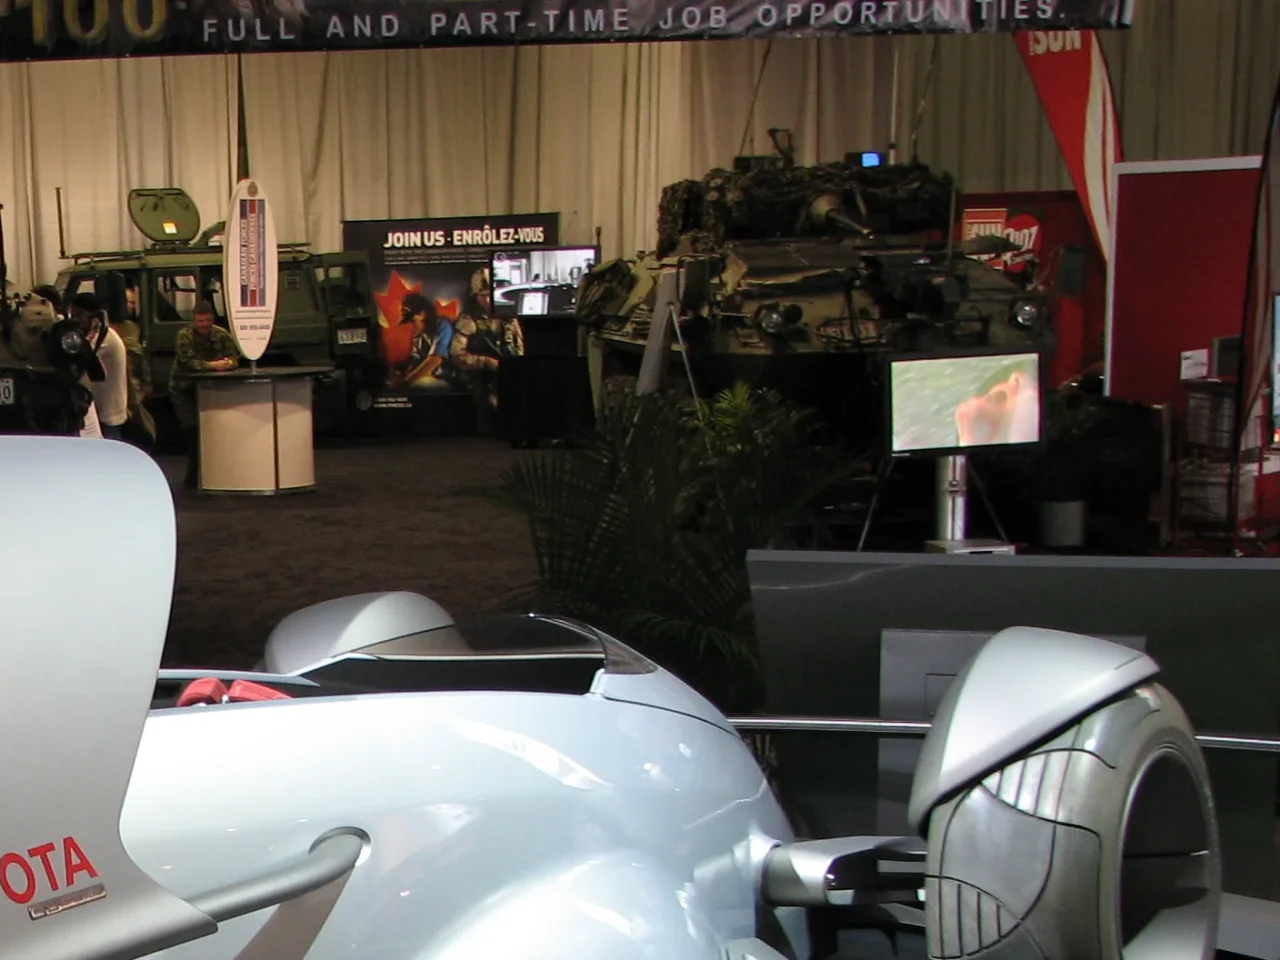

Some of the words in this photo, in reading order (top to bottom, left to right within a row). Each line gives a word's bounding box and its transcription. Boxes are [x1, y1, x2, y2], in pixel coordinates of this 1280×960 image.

[16, 0, 169, 46] 100
[202, 17, 296, 42] FULL
[326, 13, 400, 38] AND
[429, 8, 630, 36] PART-TIME
[658, 7, 728, 30] JOB
[383, 230, 421, 248] JOIN
[423, 229, 446, 247] US
[452, 224, 545, 246] ENRÔLEZ-VOUS
